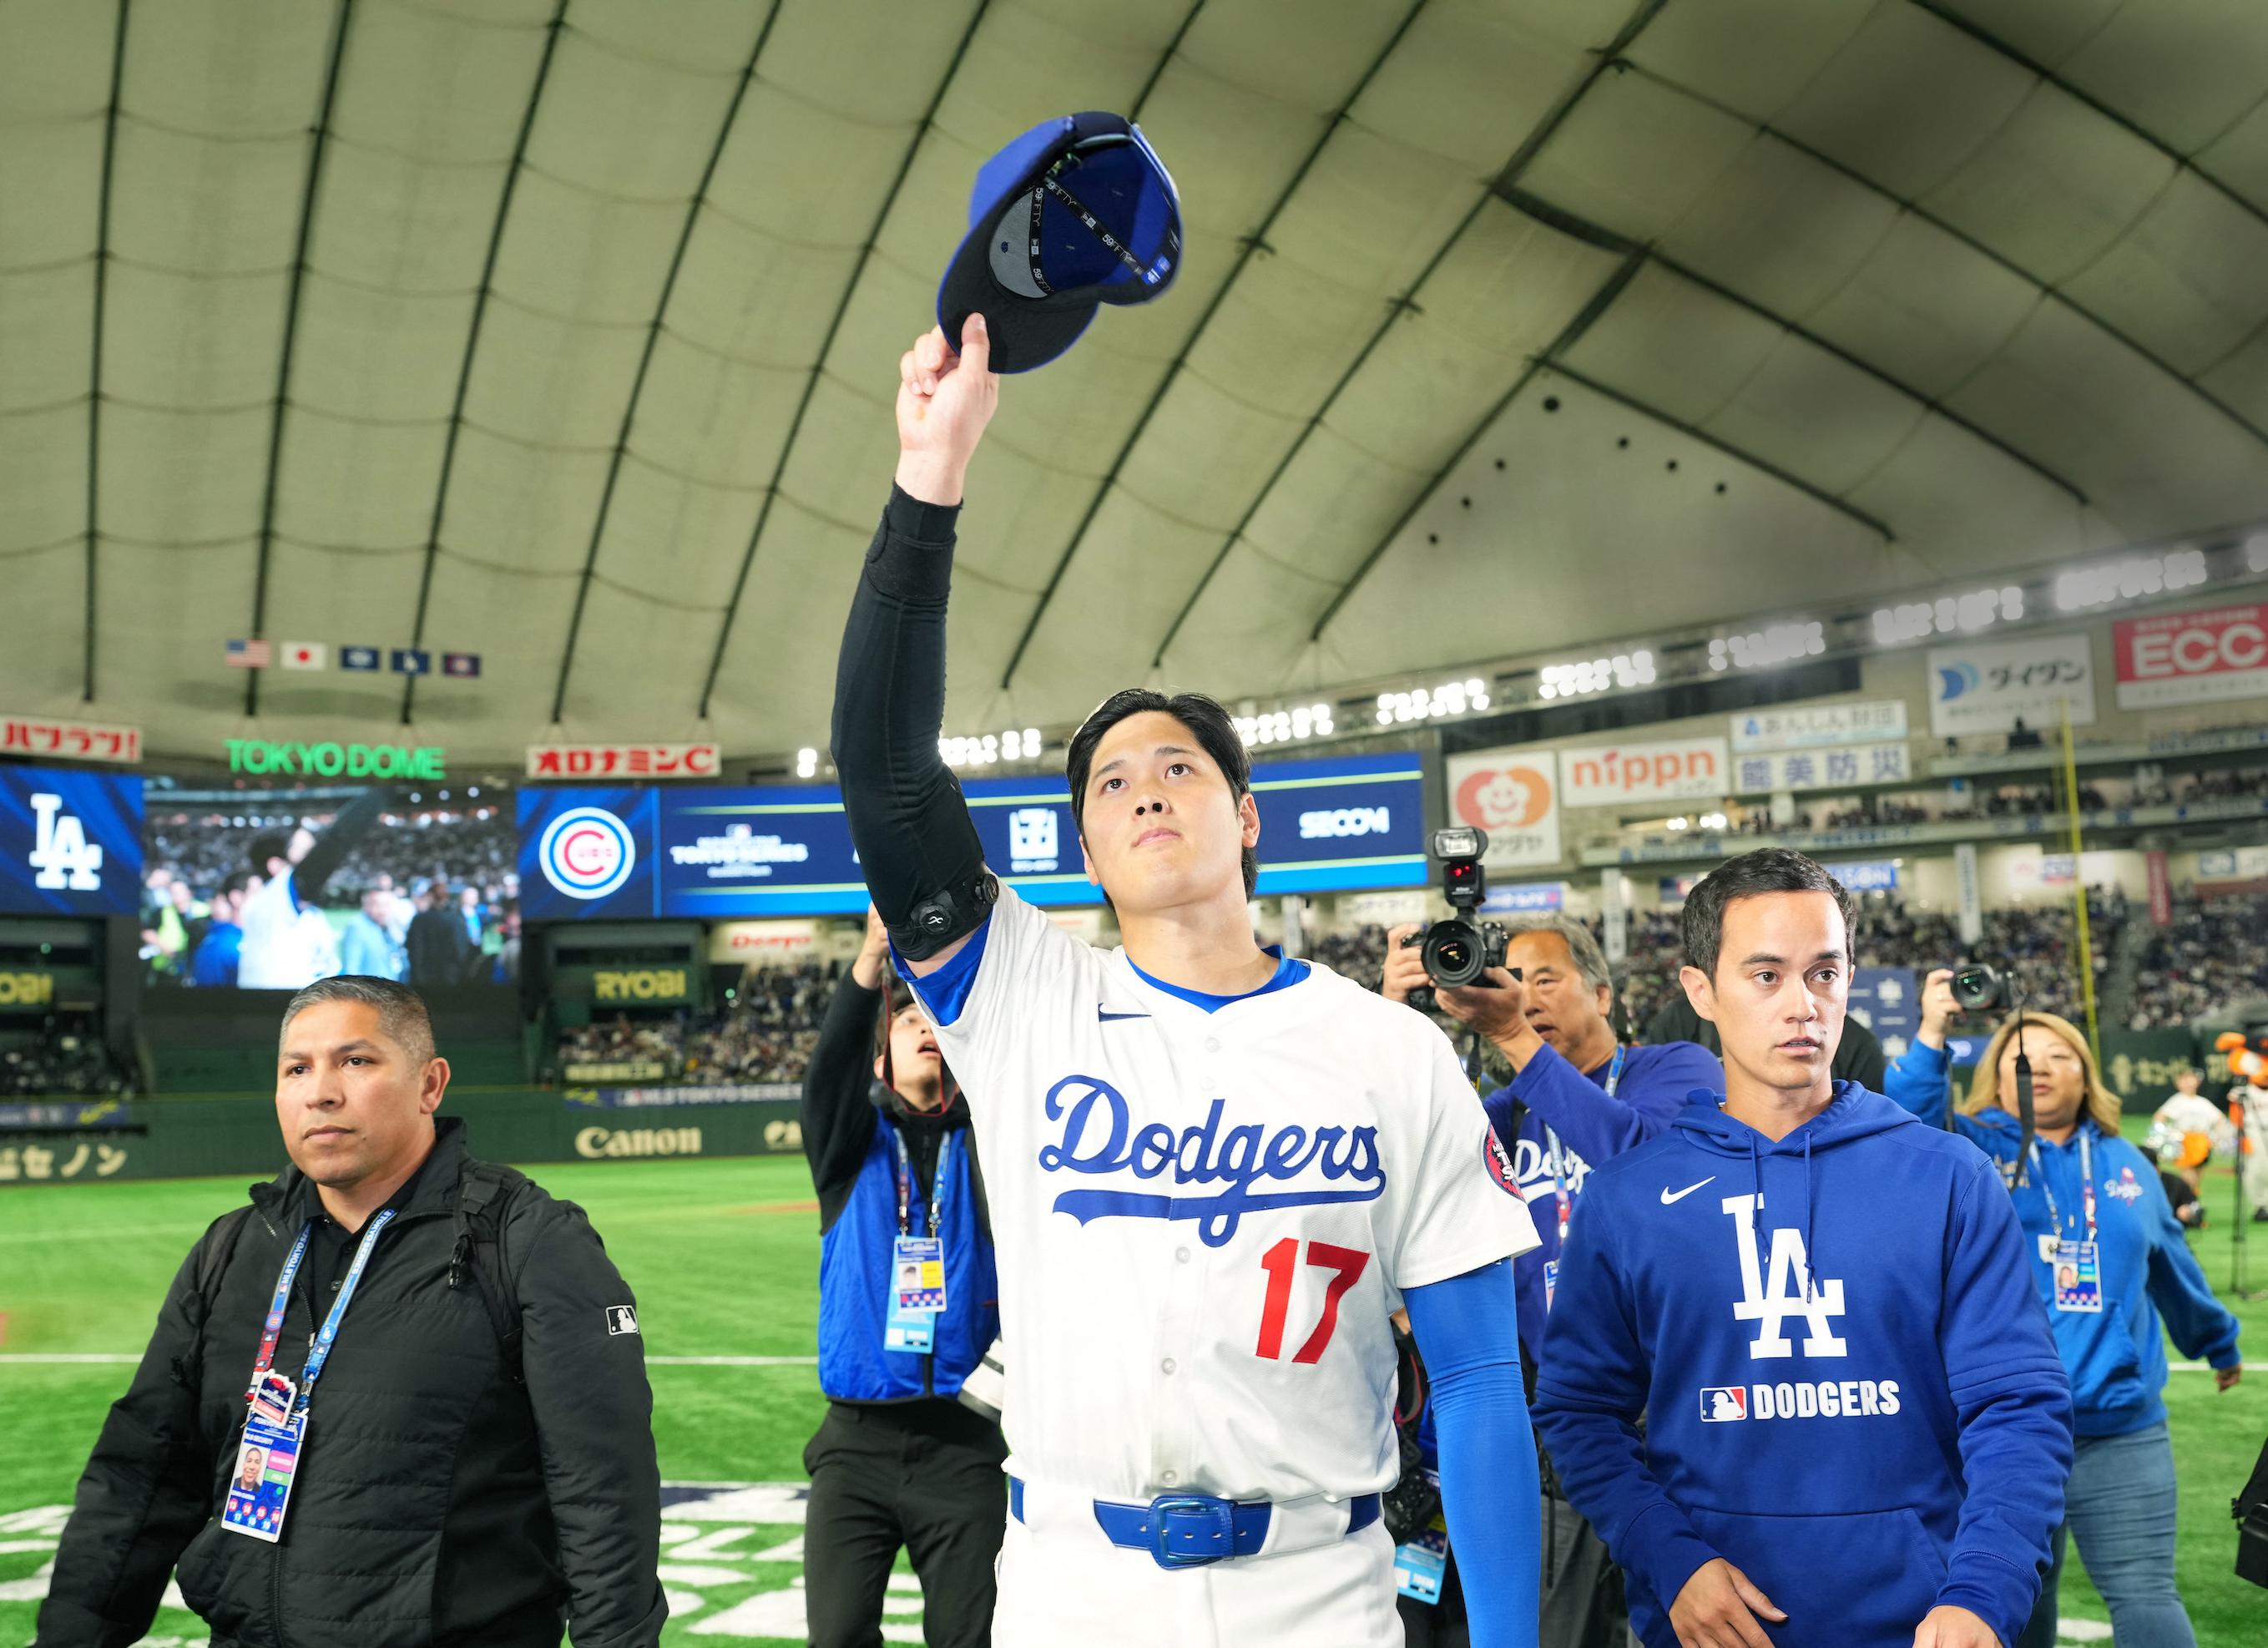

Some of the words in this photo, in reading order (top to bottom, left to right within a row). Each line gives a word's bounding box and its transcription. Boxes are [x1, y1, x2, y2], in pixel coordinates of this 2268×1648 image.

[2130, 624, 2266, 677] ECC
[223, 739, 346, 777] TOKYO
[346, 744, 447, 781] DOME
[1572, 749, 1715, 791] nippn
[594, 970, 686, 999] RYOBI
[574, 1126, 703, 1158] Canon
[1039, 1074, 1387, 1248] Dodgers
[1721, 1191, 1848, 1359] LA
[1255, 1237, 1371, 1365] 17
[1752, 1379, 1902, 1420] DODGERS
